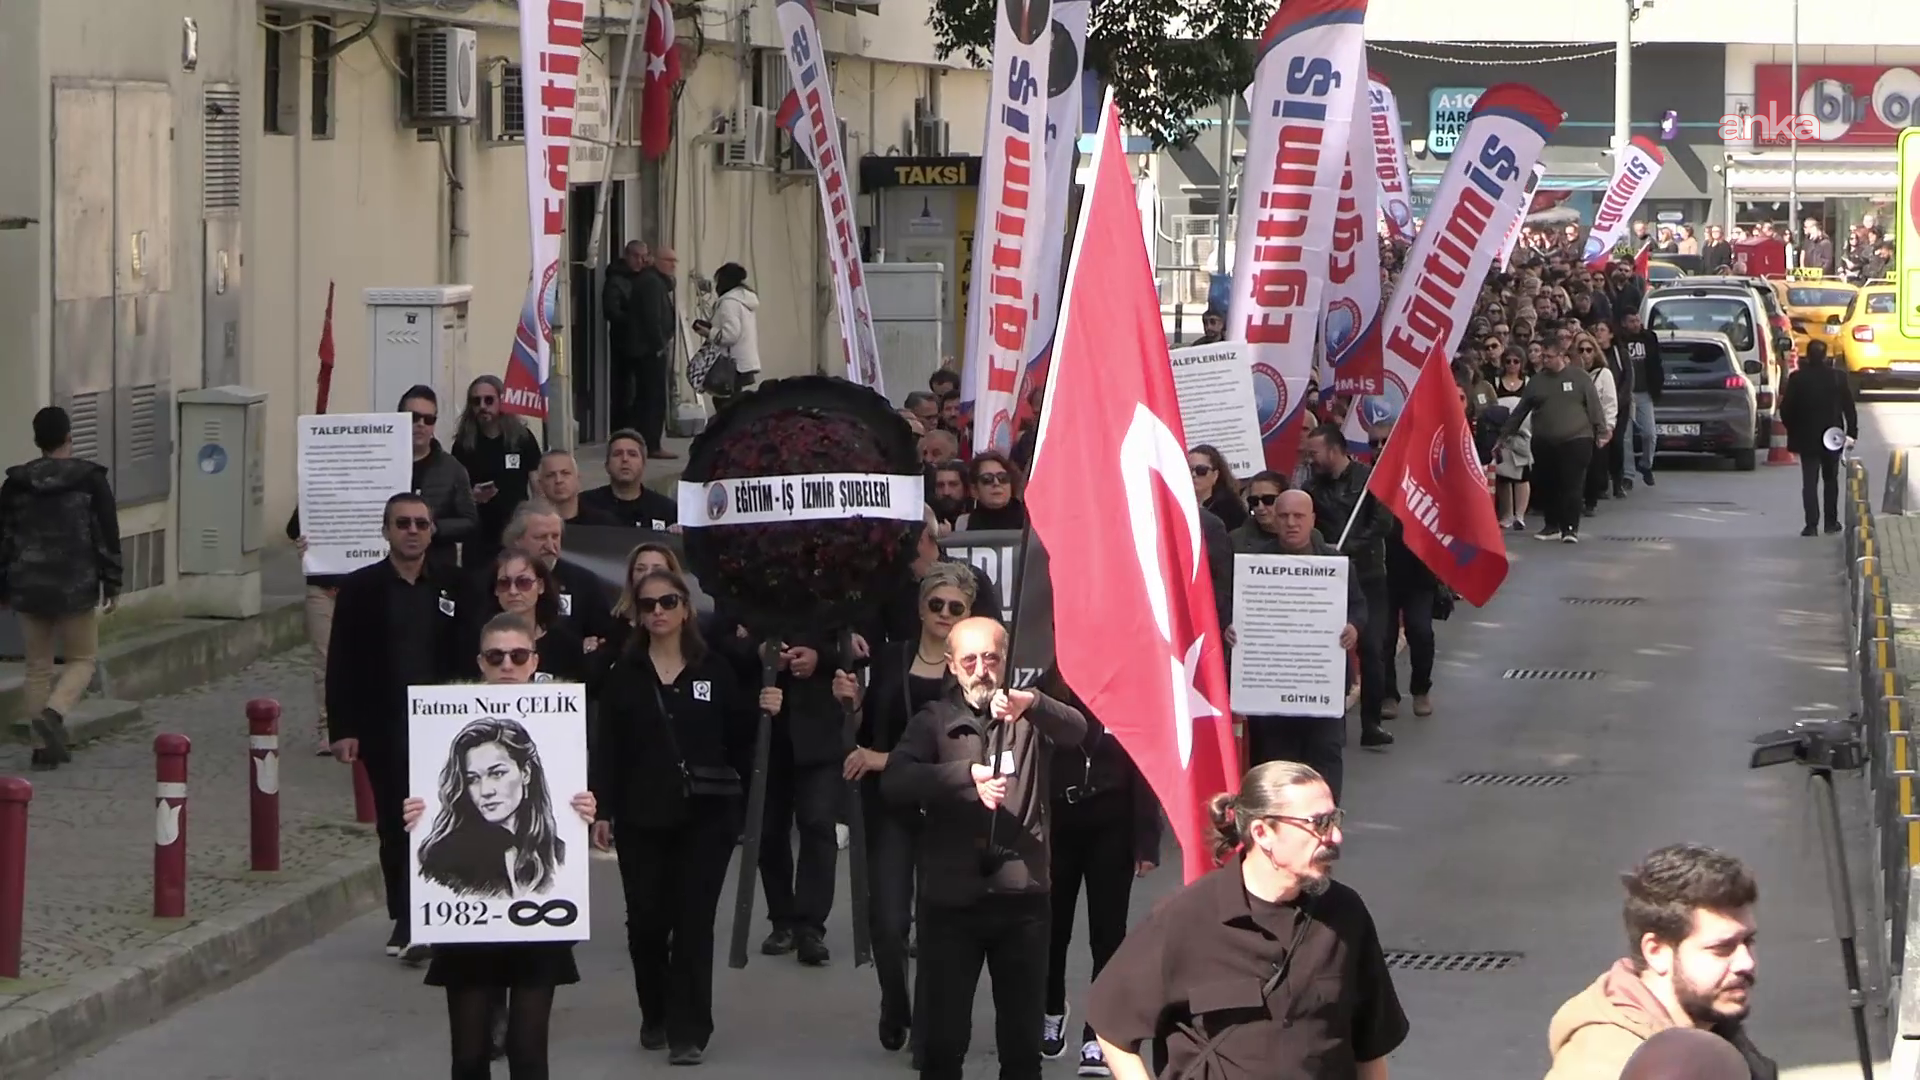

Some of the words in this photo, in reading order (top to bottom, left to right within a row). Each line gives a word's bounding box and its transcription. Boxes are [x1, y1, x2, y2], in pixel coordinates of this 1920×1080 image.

[1814, 81, 1870, 123] bir
[1436, 136, 1457, 147] BiT
[894, 162, 967, 185] TAKSİ
[1172, 352, 1237, 367] ALEPLERİMİZ
[310, 425, 394, 436] TALEPLERİMİZ
[801, 477, 835, 510] İZMİR
[839, 476, 891, 514] ŞUBELERİ
[346, 549, 380, 559] EĞİTİM
[1249, 565, 1336, 577] TALEPLERİMİZ
[1281, 693, 1317, 703] EĞİTİM
[411, 698, 469, 716] Fatma
[474, 697, 511, 715] Nur
[516, 692, 579, 719] ÇELİK
